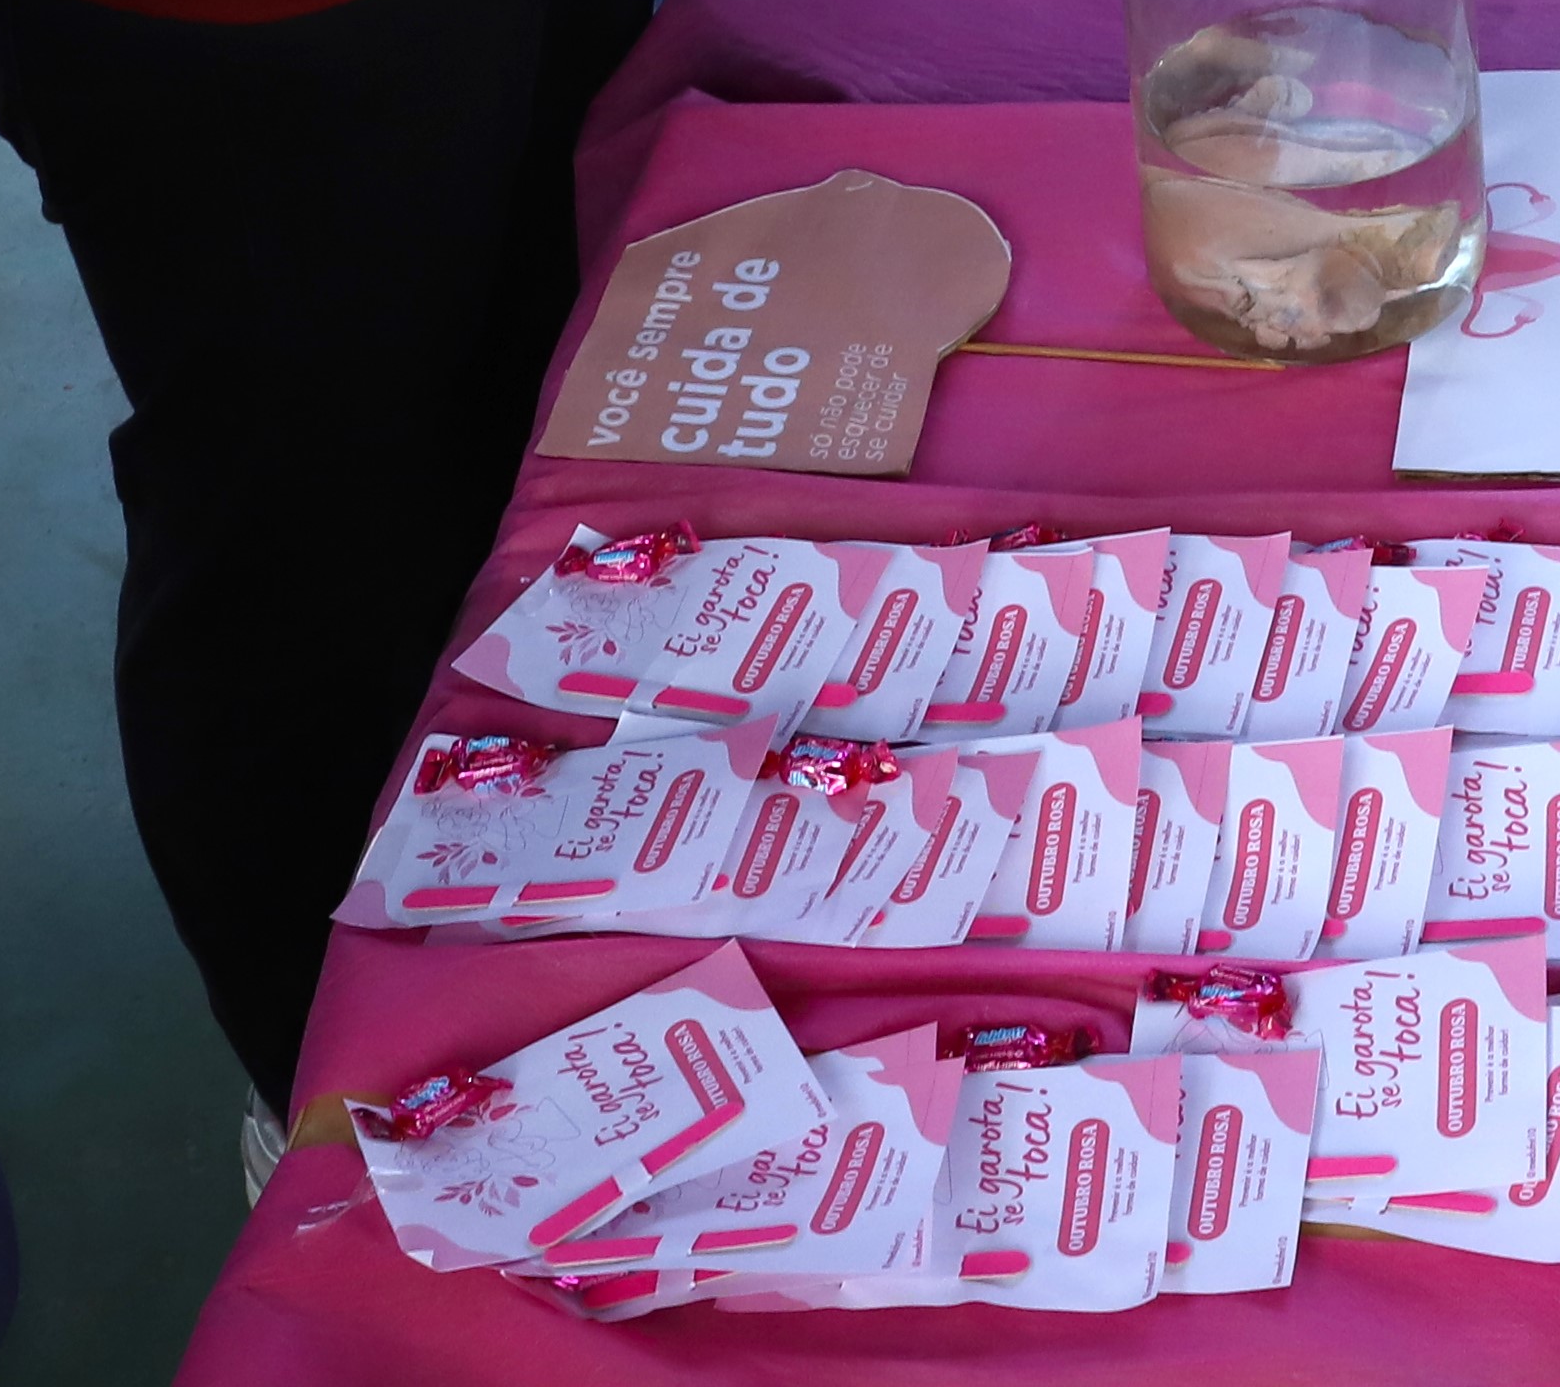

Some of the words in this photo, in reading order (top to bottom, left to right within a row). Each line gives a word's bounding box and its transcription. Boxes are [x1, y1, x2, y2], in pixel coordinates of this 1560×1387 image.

[586, 368, 648, 446] você
[627, 250, 702, 362] sempre
[660, 326, 753, 453] cuida
[711, 257, 781, 312] de
[835, 343, 867, 391] pode
[716, 345, 811, 459] tudo
[809, 432, 833, 460] só
[820, 395, 847, 429] não
[838, 371, 882, 460] esquecer
[867, 344, 894, 369] de
[875, 372, 909, 432] cuidar
[865, 437, 888, 462] se
[663, 632, 698, 658] Ei
[695, 553, 745, 627] garota
[741, 626, 783, 689] OUTUBRO
[775, 586, 807, 628] ROSA
[857, 629, 893, 692] OUTUBRO
[889, 591, 911, 629] ROSA
[1171, 621, 1202, 685] OUTUBRO
[1192, 581, 1214, 623] ROSA
[1258, 634, 1286, 698] OUTUBRO
[1278, 597, 1296, 633] ROSA
[1352, 664, 1390, 728] OUTUBRO
[1381, 621, 1410, 664] ROSA
[554, 838, 590, 862] Ei
[583, 760, 626, 830] garota
[642, 808, 680, 868] OUTUBRO
[672, 774, 696, 810] ROSA
[742, 834, 776, 894] OUTUBRO
[766, 797, 790, 835] ROSA
[1036, 832, 1060, 910] OUTUBRO
[1049, 786, 1067, 833] ROSA
[1336, 841, 1365, 915] OUTUBRO
[1353, 792, 1374, 840] ROSA
[1451, 772, 1487, 863] garota
[1233, 850, 1260, 926] OUTUBRO
[1249, 804, 1266, 844] ROSA
[1448, 872, 1490, 901] Ei
[673, 1023, 702, 1063] ROSA
[1340, 981, 1376, 1076] garota
[1449, 1002, 1467, 1049] ROSA
[556, 1042, 623, 1114] garota
[1334, 1090, 1379, 1120] Ei
[1447, 1052, 1466, 1132] OUTUBRO
[594, 1113, 641, 1147] Ei
[851, 1126, 876, 1171] ROSA
[969, 1094, 1005, 1196] garota
[1079, 1123, 1098, 1172] ROSA
[1198, 1158, 1225, 1235] OUTUBRO
[1213, 1110, 1232, 1157] ROSA
[955, 1205, 1000, 1235] Ei
[1068, 1173, 1093, 1251] OUTUBRO
